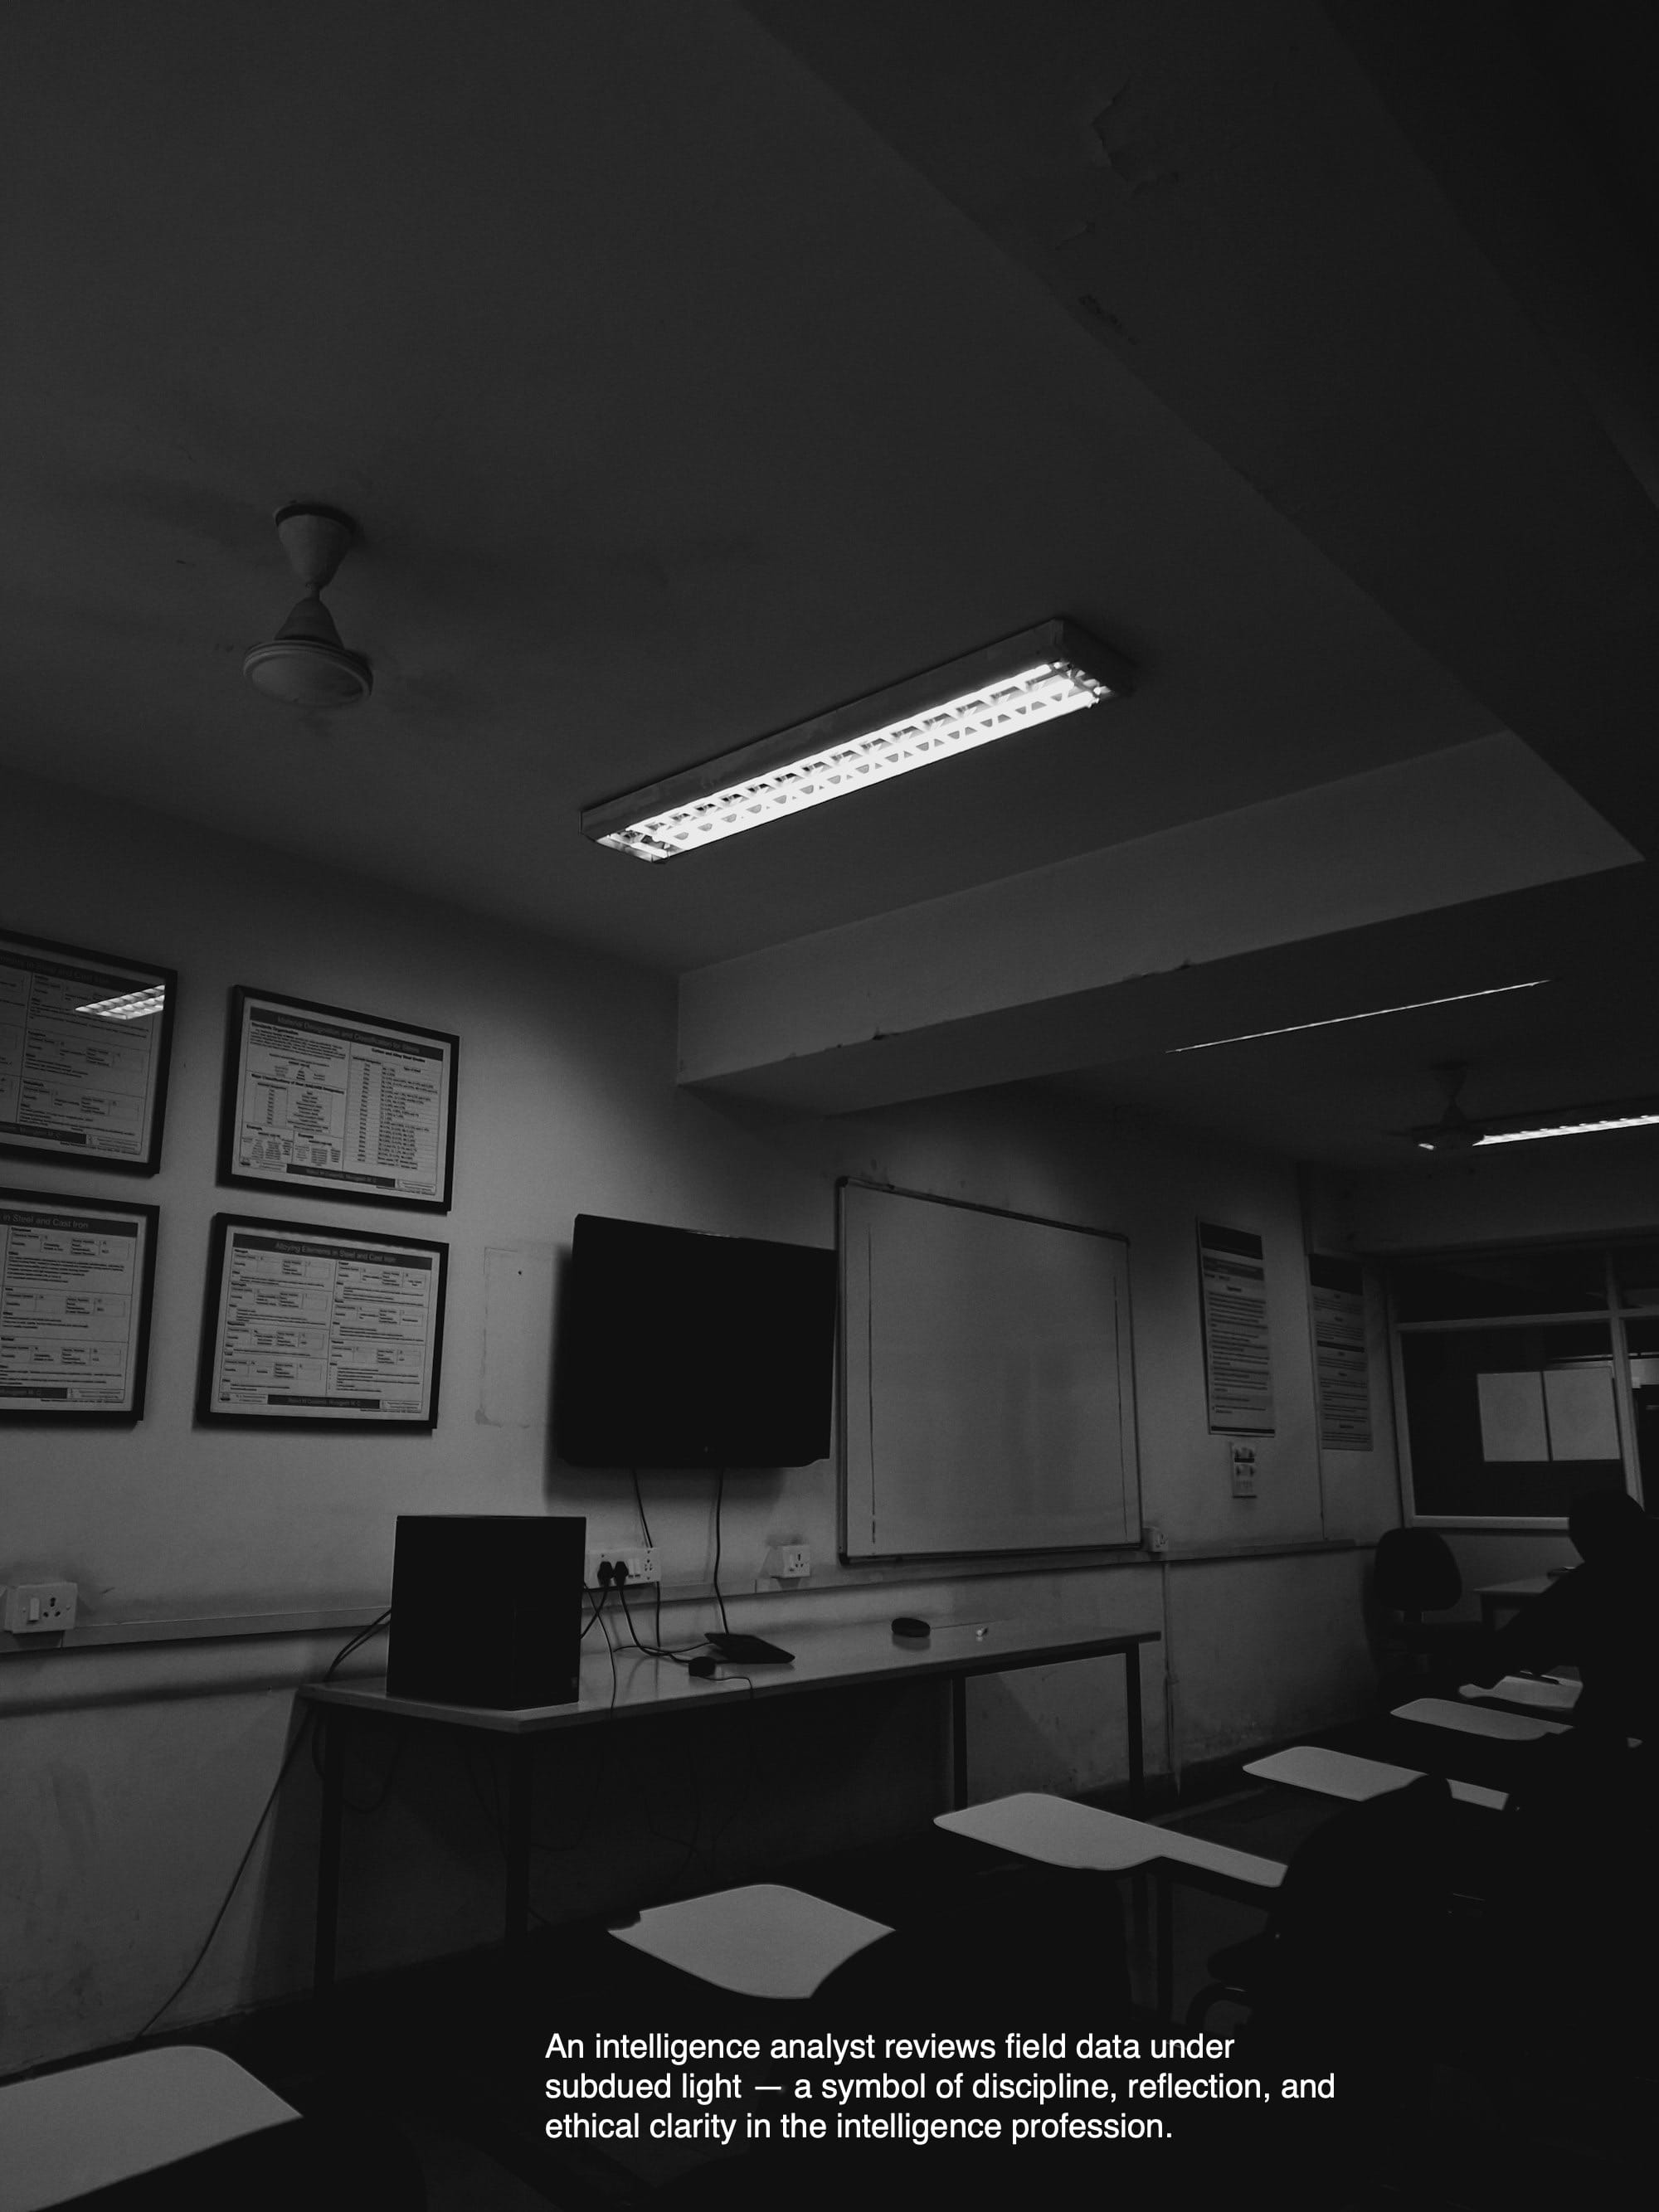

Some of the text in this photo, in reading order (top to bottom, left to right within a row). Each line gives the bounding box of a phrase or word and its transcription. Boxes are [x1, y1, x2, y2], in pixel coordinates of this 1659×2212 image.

[12, 1213, 33, 1223] Steel
[36, 1217, 51, 1226] and
[52, 1218, 71, 1228] Cast
[72, 1220, 89, 1229] Iron
